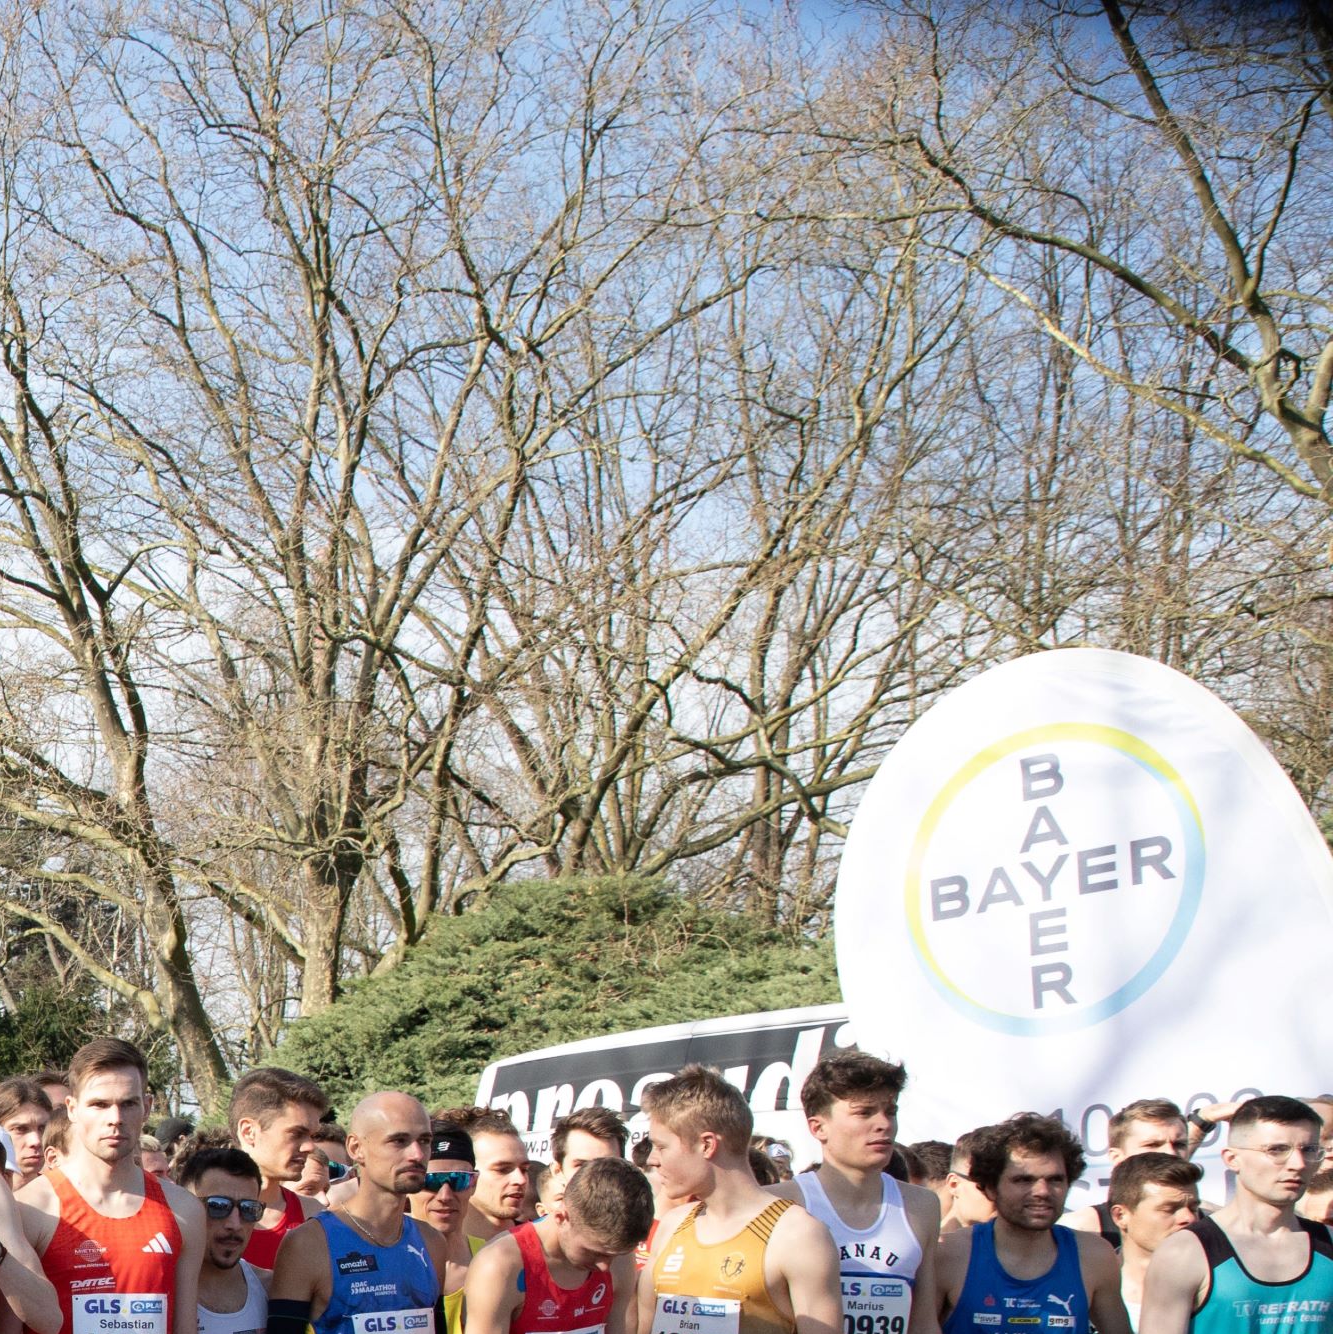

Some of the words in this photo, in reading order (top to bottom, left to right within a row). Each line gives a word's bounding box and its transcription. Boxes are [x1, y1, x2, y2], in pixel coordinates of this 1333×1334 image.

[930, 833, 1178, 922] BAYER
[1019, 752, 1078, 1011] BAYER
[840, 1243, 899, 1267] ANAU
[340, 1259, 368, 1270] amazfit
[70, 1276, 116, 1289] DATEC
[350, 1280, 368, 1289] ADAC
[358, 1283, 397, 1294] MARATHON
[840, 1281, 867, 1297] LS.
[704, 1305, 726, 1314] PLAN
[847, 1300, 884, 1311] Marius
[1258, 1299, 1331, 1315] REFRATH
[99, 1318, 154, 1329] Sebastian
[679, 1319, 700, 1331] Brian
